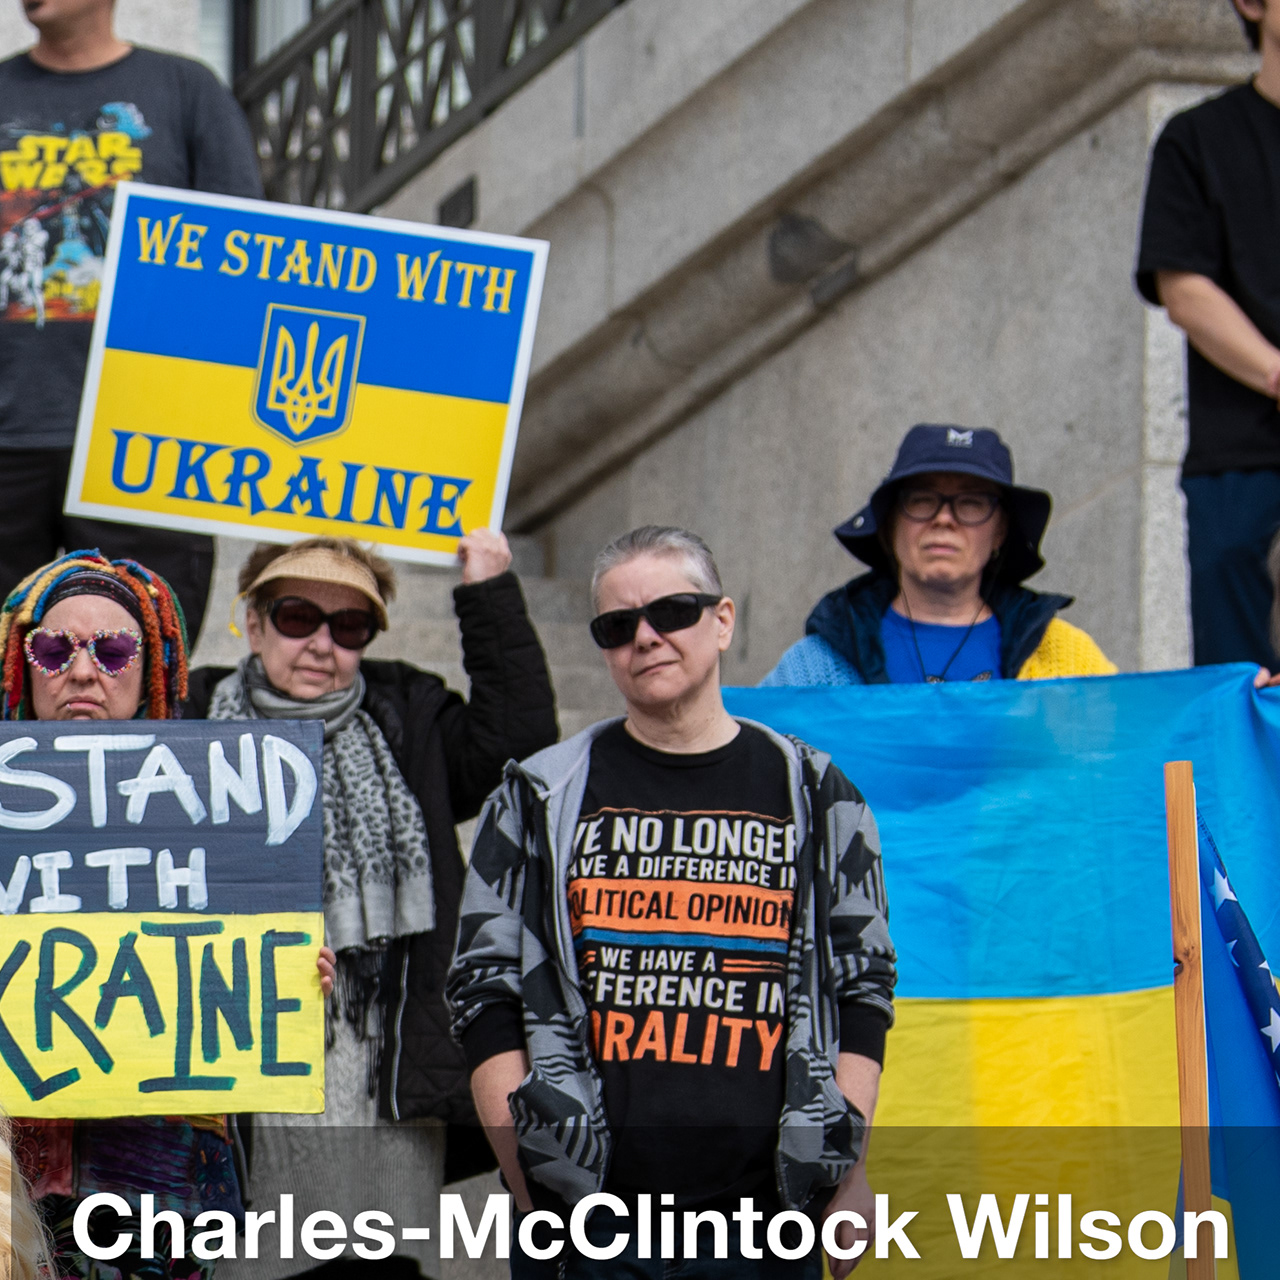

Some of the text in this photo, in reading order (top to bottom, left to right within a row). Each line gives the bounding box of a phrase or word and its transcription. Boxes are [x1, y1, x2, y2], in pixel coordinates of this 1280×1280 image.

[136, 212, 518, 314] WE STAND WITH
[110, 428, 474, 539] UKRAINE
[611, 815, 664, 854] NO
[613, 854, 630, 878] A
[637, 855, 772, 888] DIFFERENCE
[570, 887, 679, 921] OLITICAL
[600, 945, 717, 973] WE HAVE A
